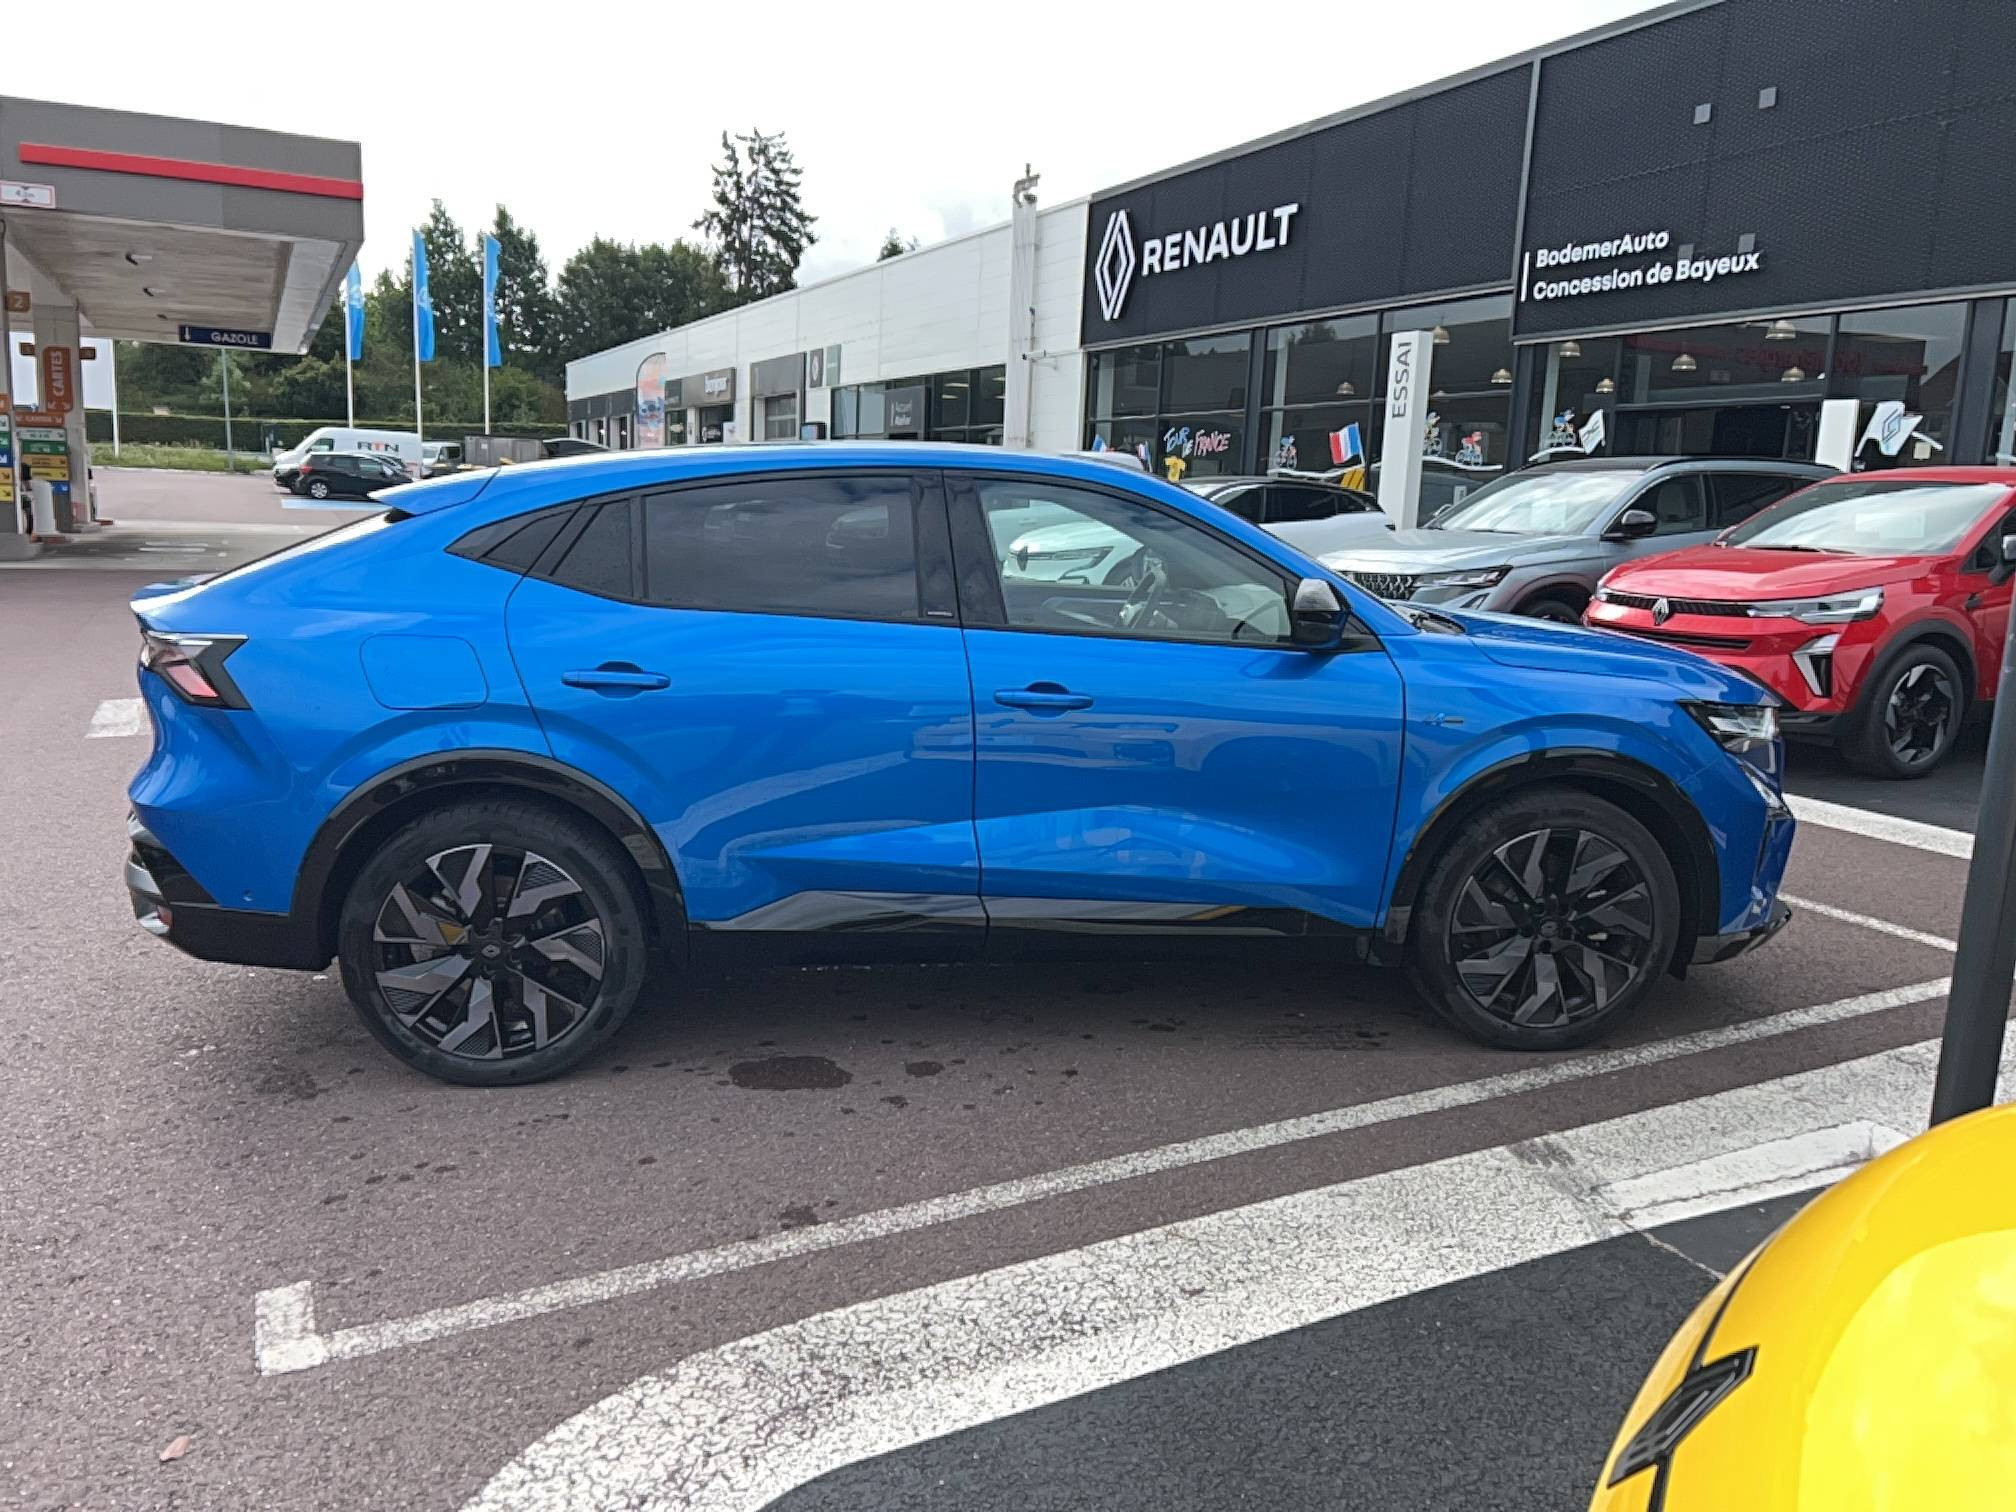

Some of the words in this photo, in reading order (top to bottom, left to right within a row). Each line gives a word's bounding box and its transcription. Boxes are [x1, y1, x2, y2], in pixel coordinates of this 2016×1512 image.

[1142, 203, 1299, 276] RENAULT
[1536, 231, 1669, 267] BodemerAuto
[1533, 268, 1643, 300] Concession
[1646, 262, 1673, 284] de
[1675, 252, 1760, 281] Bayeux
[210, 331, 259, 345] GAZOLE
[51, 350, 65, 397] CARTES
[1392, 342, 1412, 418] ESSAI
[1194, 429, 1231, 456] FRANCE
